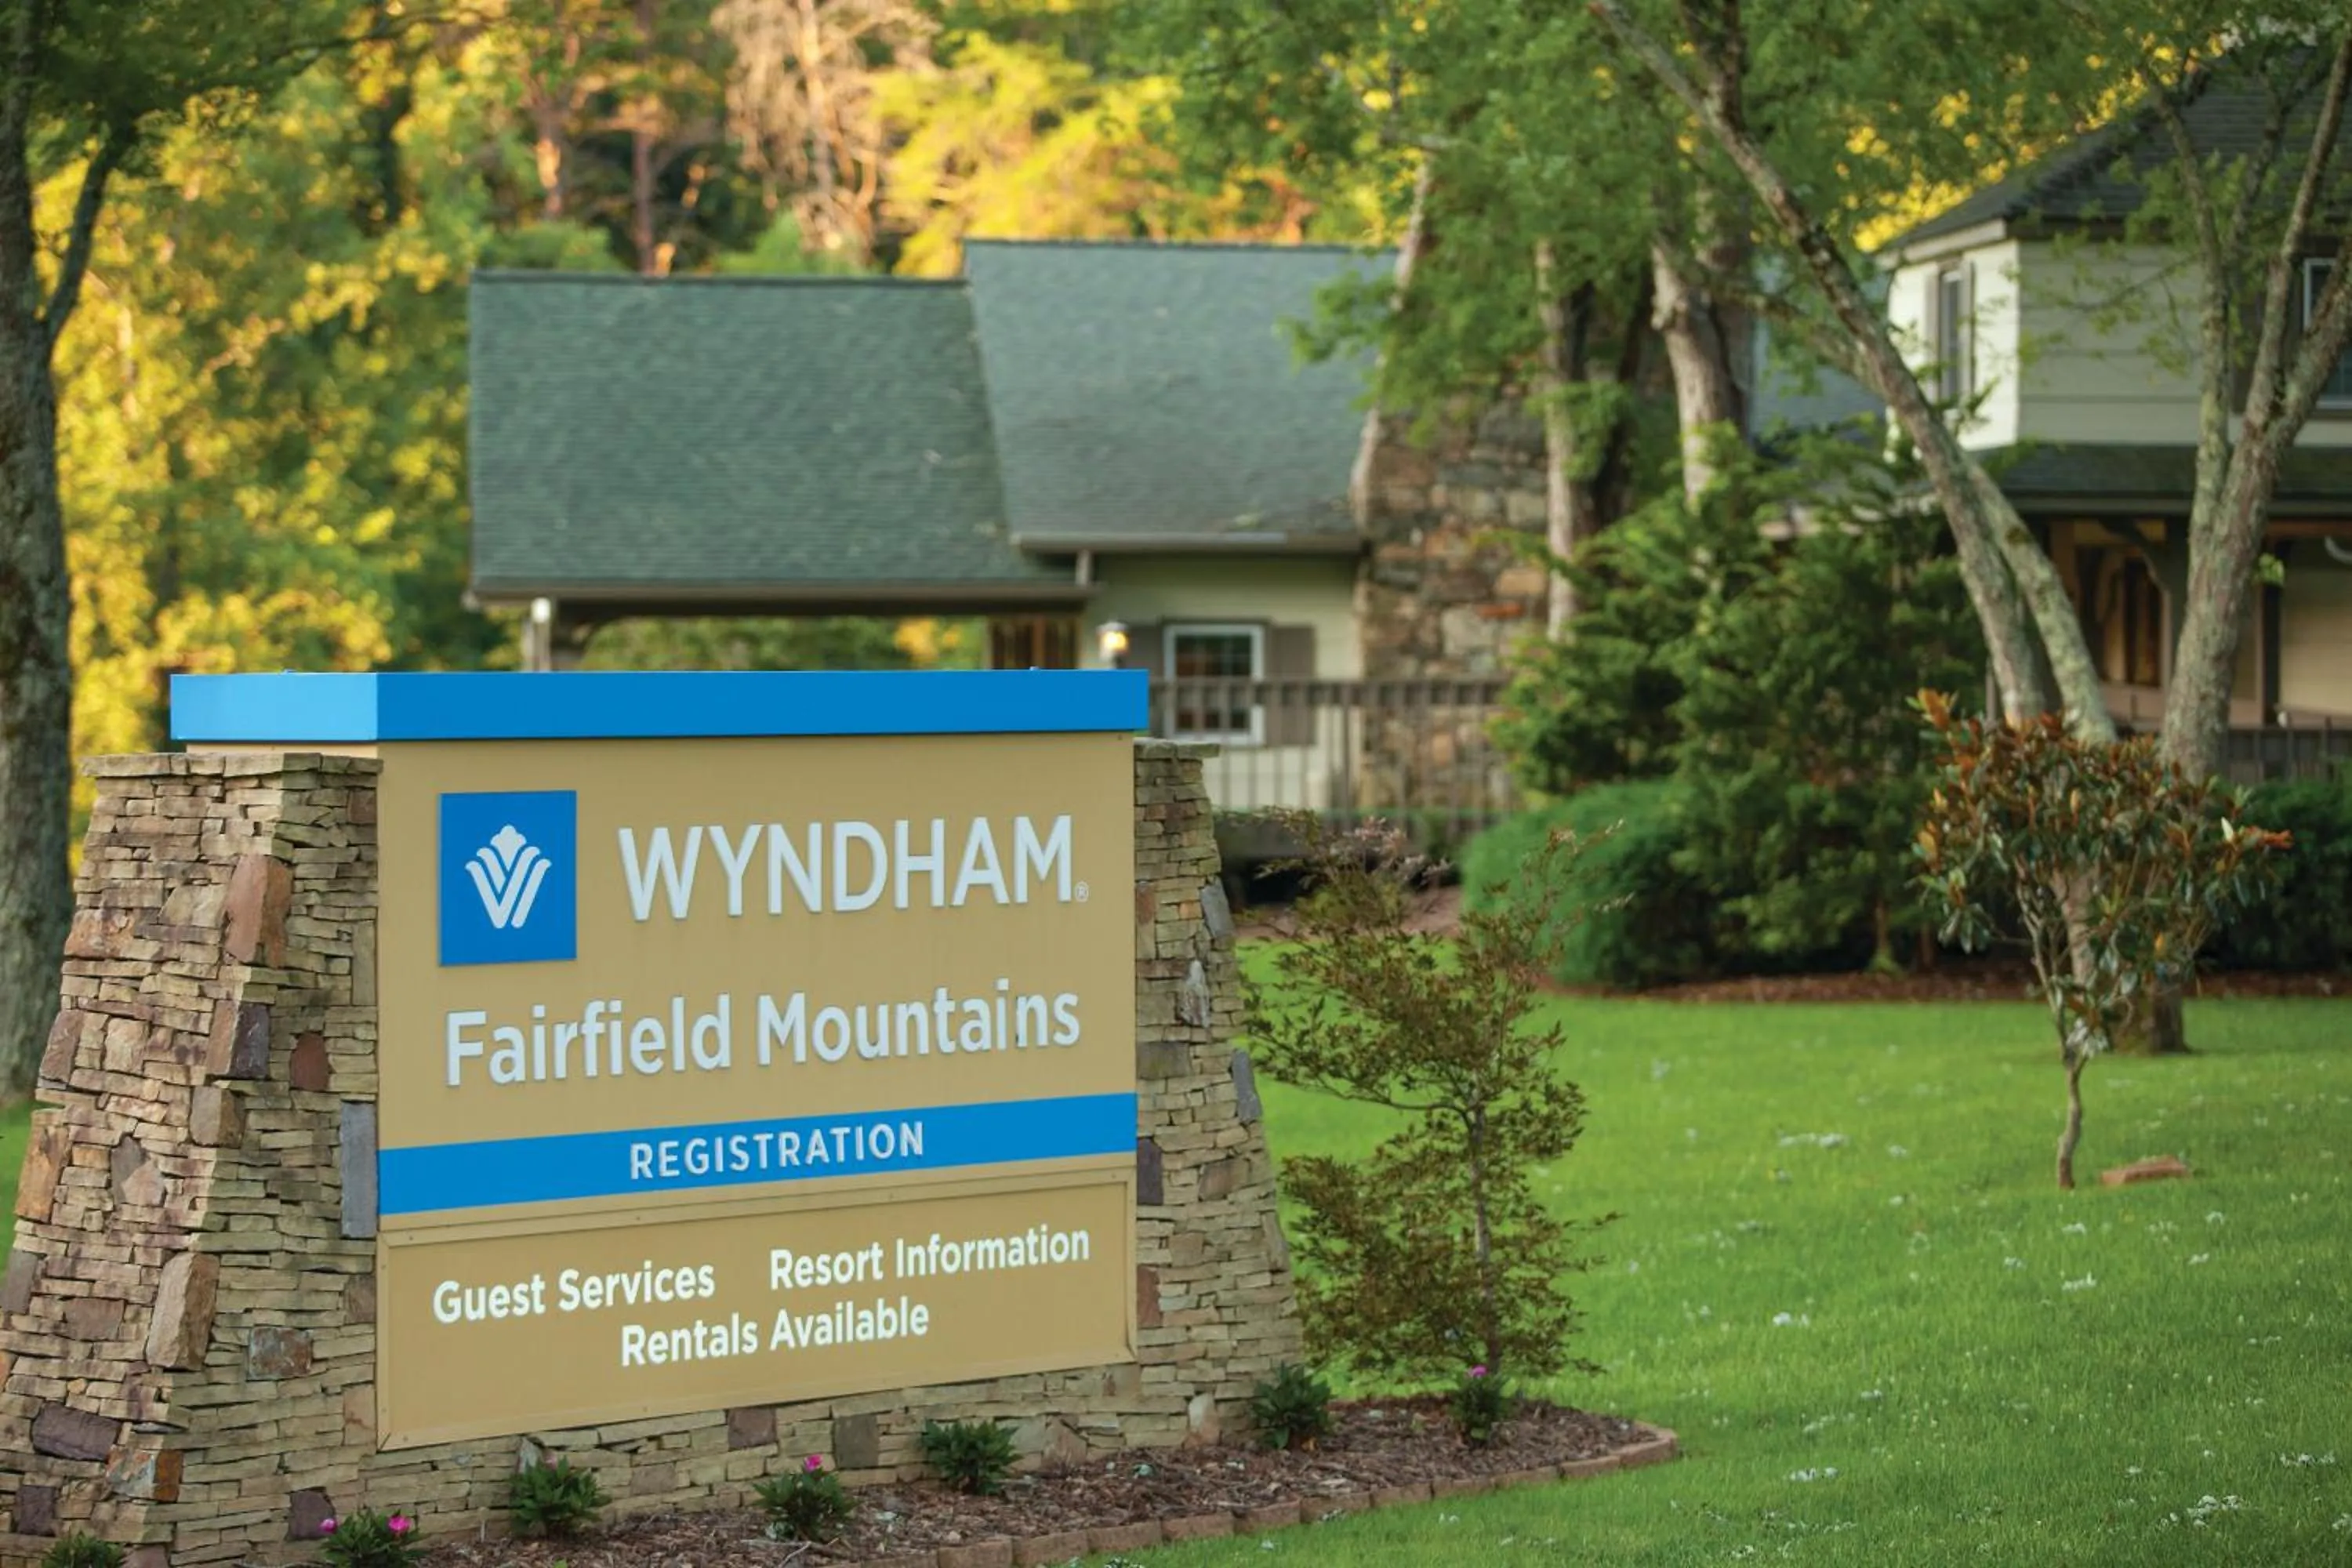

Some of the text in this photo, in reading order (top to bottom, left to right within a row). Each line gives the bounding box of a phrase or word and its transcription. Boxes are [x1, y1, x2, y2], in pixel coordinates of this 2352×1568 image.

[447, 978, 1080, 1087] Fairfield Mountains
[630, 1121, 924, 1180] REGISTRATION
[770, 1223, 1090, 1290] Resort Information
[432, 1260, 715, 1323] Guest Services
[621, 1295, 929, 1367] Rentals Available
